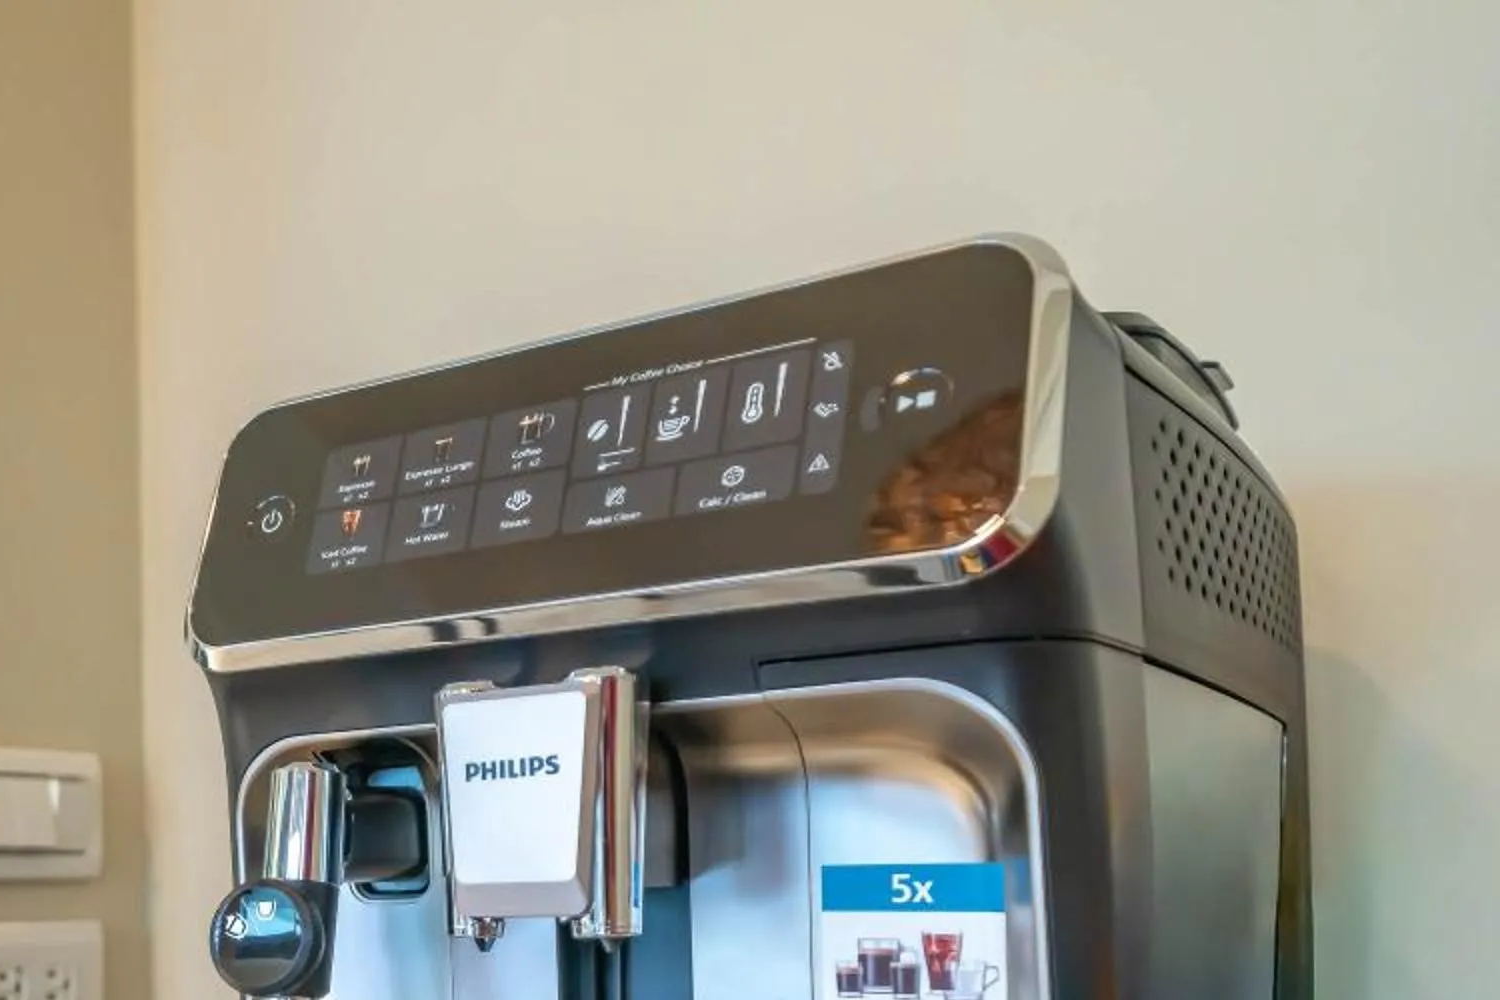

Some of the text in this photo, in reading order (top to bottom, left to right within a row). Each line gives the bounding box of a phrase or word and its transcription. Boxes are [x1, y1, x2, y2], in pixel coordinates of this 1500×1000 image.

[611, 359, 703, 386] My Coffee Choice
[699, 495, 726, 508] Calc
[464, 754, 561, 782] PHILIPS
[891, 873, 934, 904] 5x
